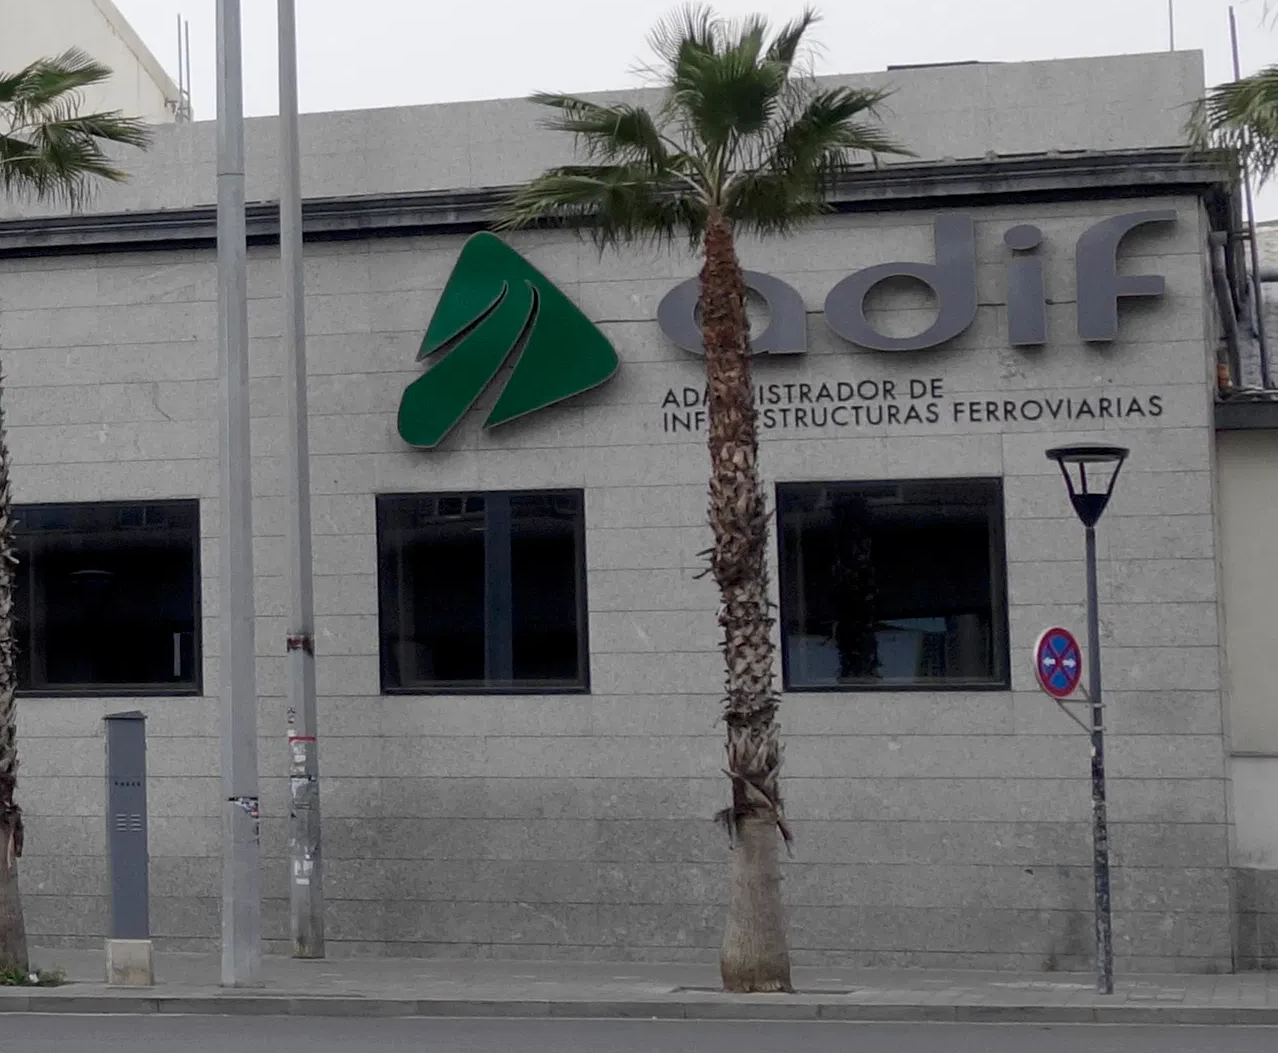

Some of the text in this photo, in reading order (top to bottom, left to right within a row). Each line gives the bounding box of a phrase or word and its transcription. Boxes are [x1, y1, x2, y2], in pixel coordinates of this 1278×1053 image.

[657, 208, 1178, 355] adif
[661, 378, 944, 409] ADISTRADOR DE
[663, 395, 1164, 432] INFSTRUCTURAS FERROVIARIAS
